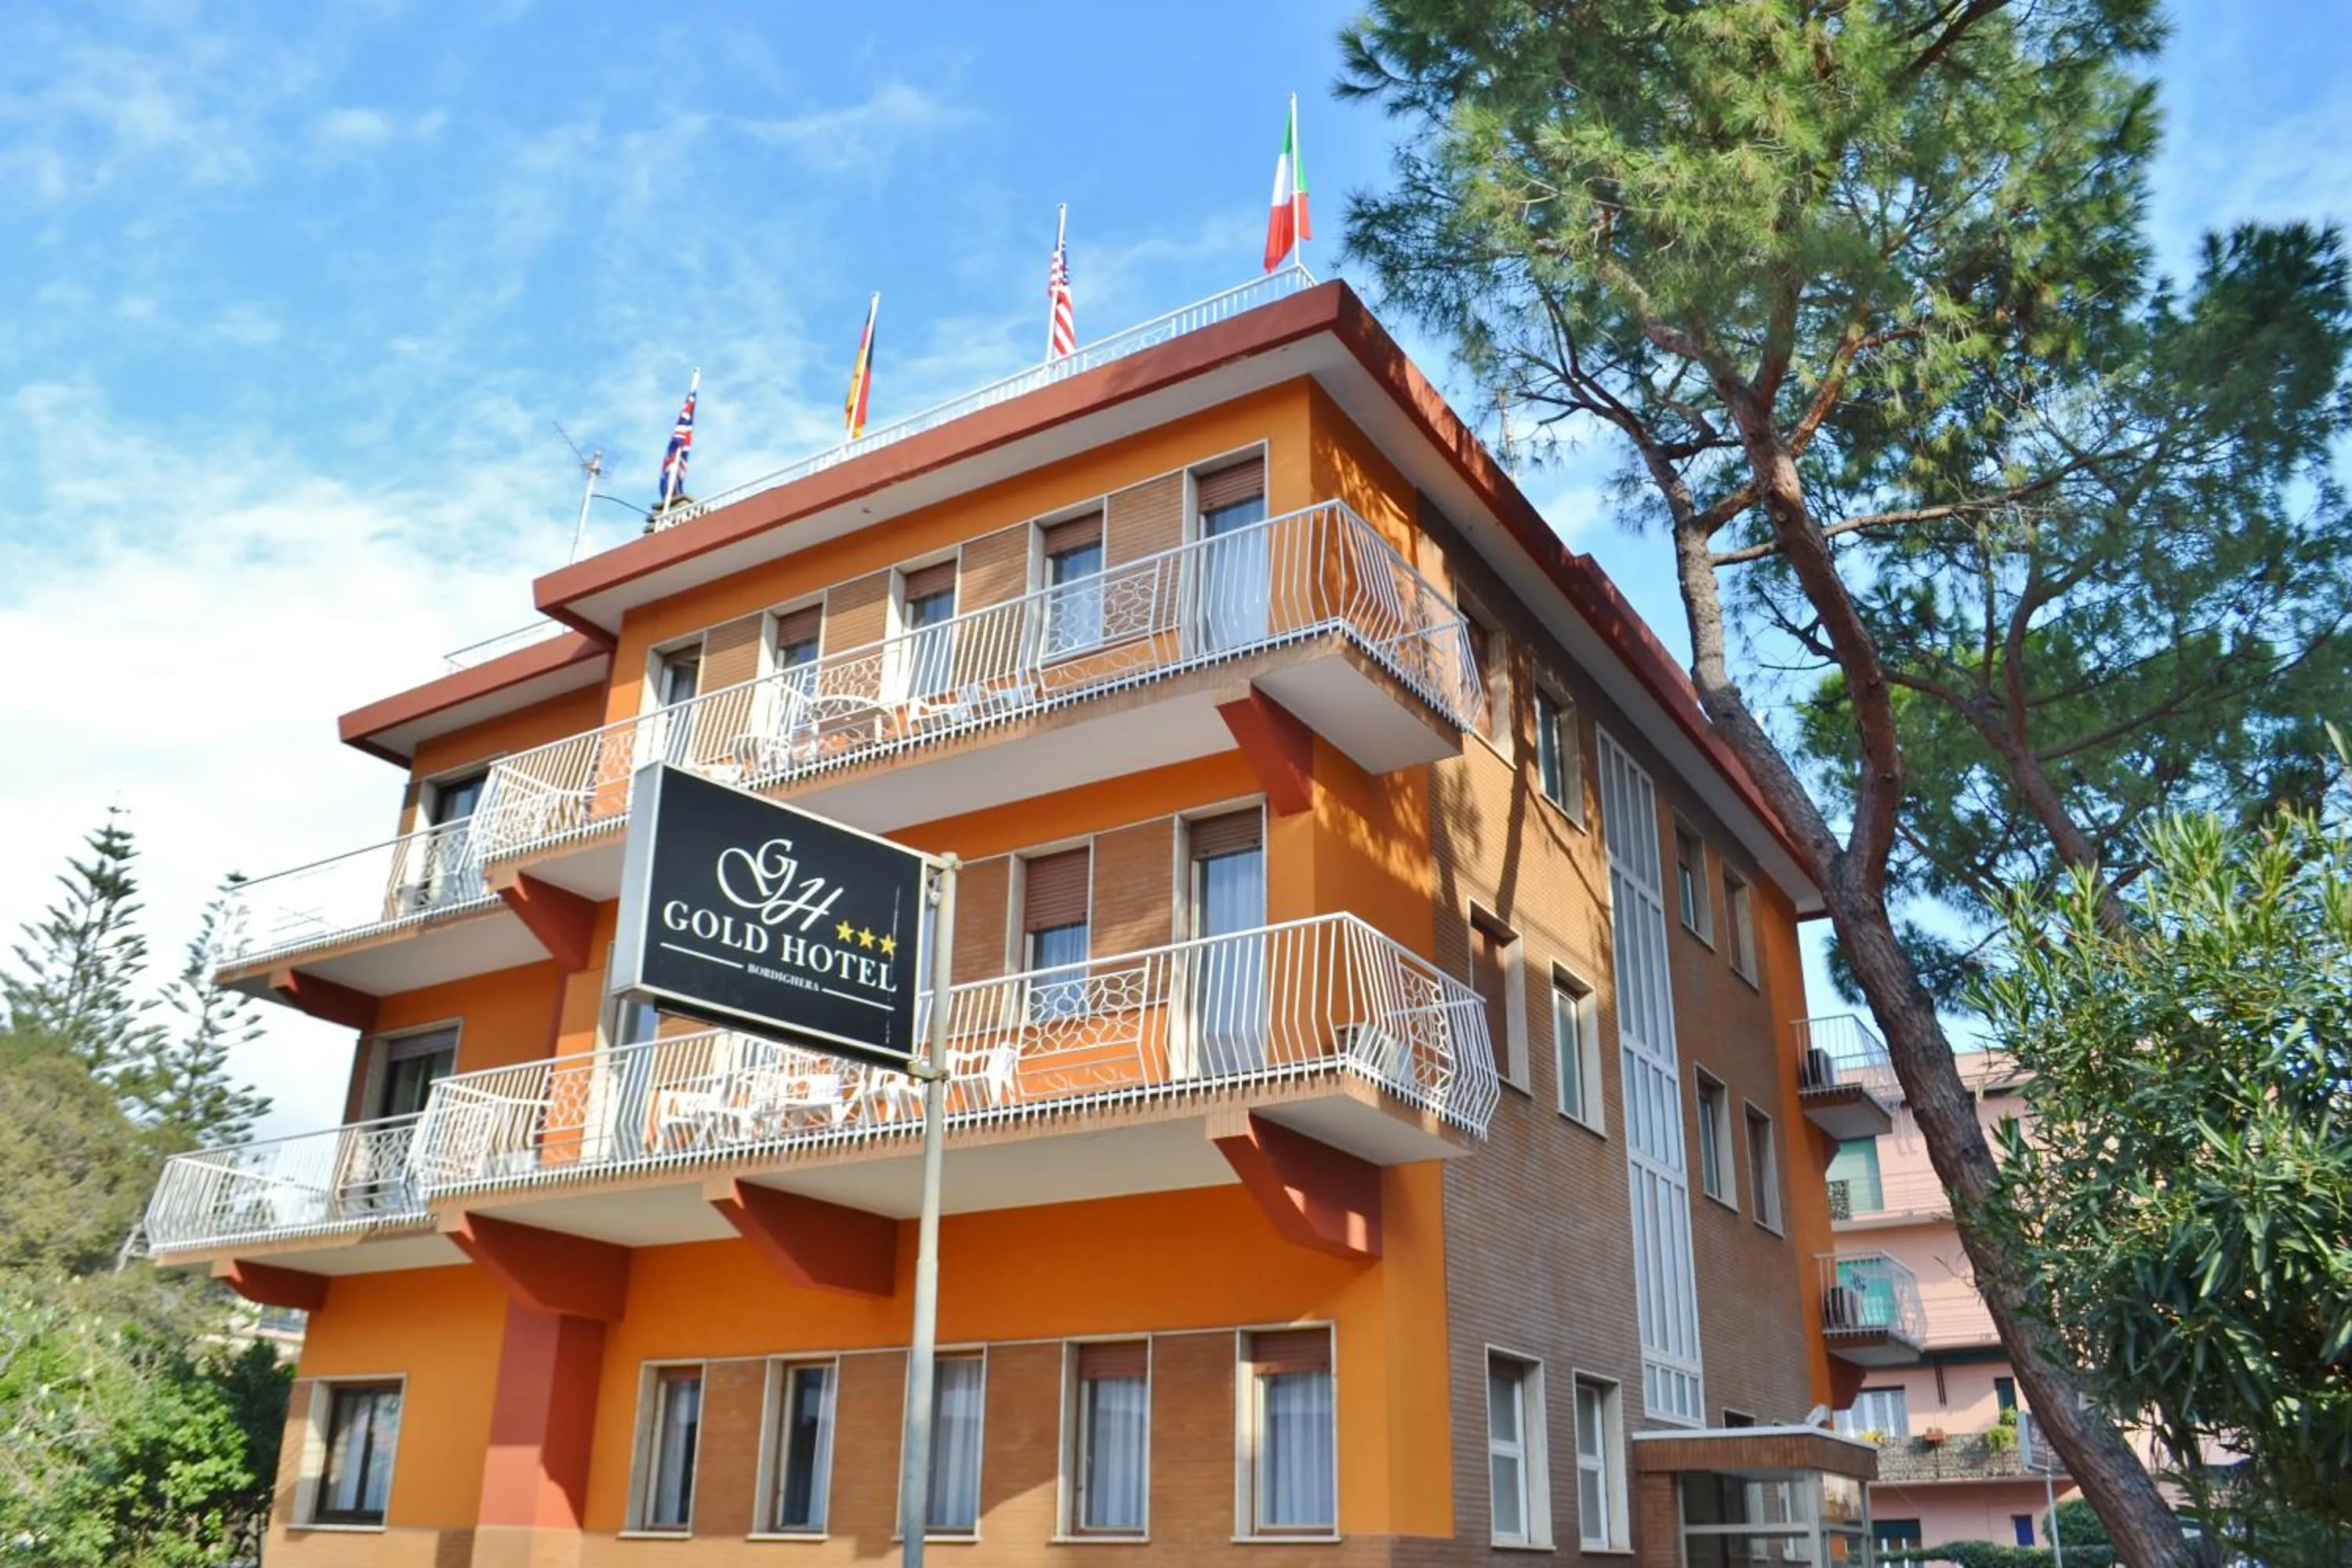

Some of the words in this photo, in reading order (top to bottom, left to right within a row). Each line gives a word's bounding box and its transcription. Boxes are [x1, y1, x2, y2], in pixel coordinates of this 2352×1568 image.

[663, 901, 768, 954] GOLD
[781, 934, 897, 993] HOTEL
[747, 964, 819, 992] BORDIGHERA
